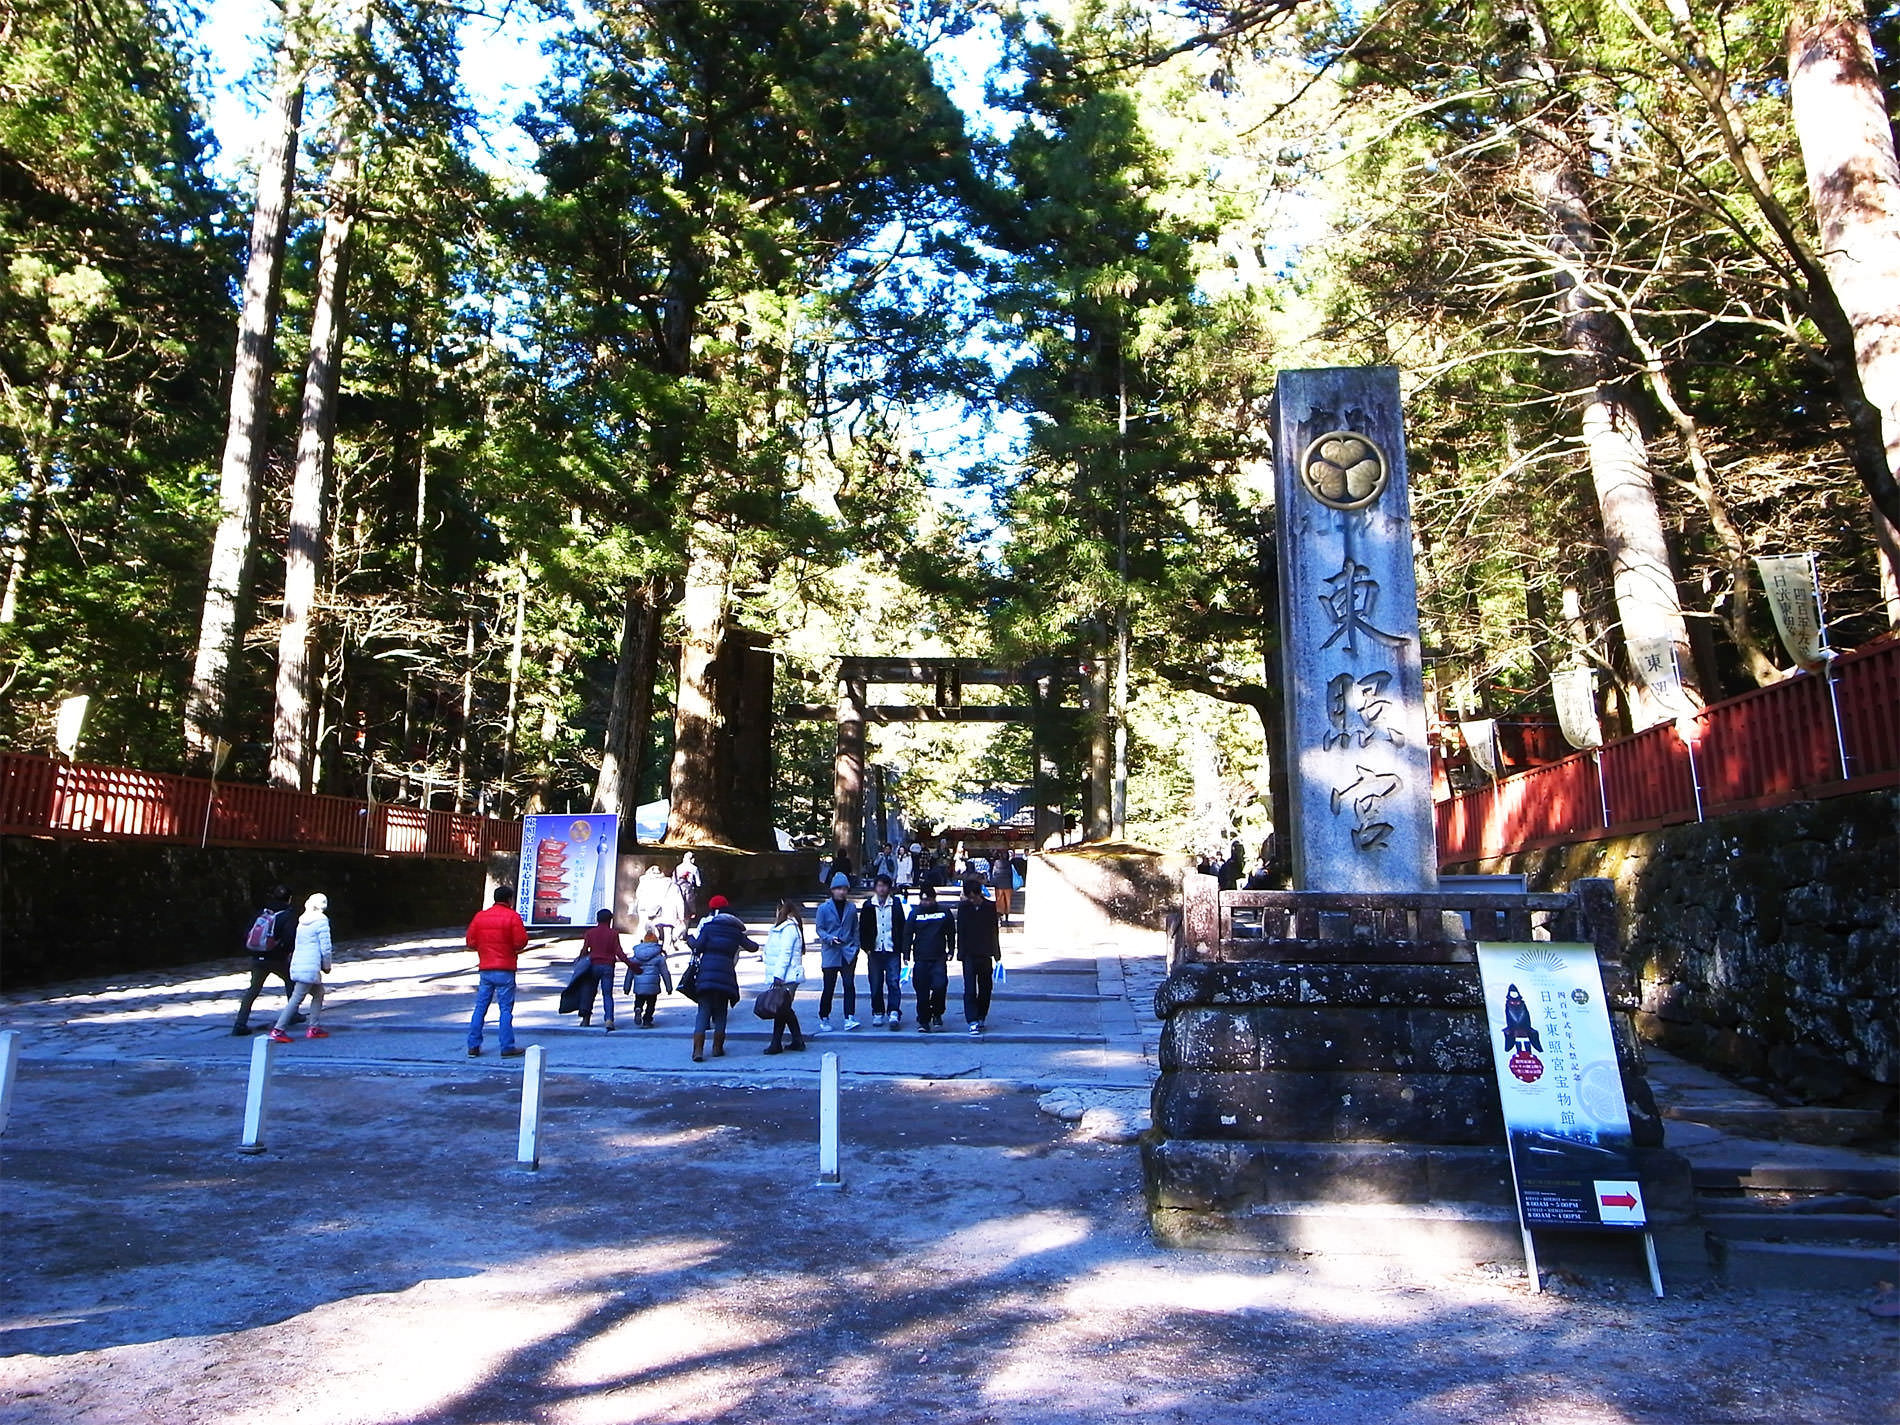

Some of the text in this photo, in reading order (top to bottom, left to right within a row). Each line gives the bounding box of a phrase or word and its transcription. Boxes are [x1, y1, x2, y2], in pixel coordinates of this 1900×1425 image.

[1318, 556, 1411, 850] 東照宮
[1540, 990, 1576, 1126] 日光東照宮宝物館
